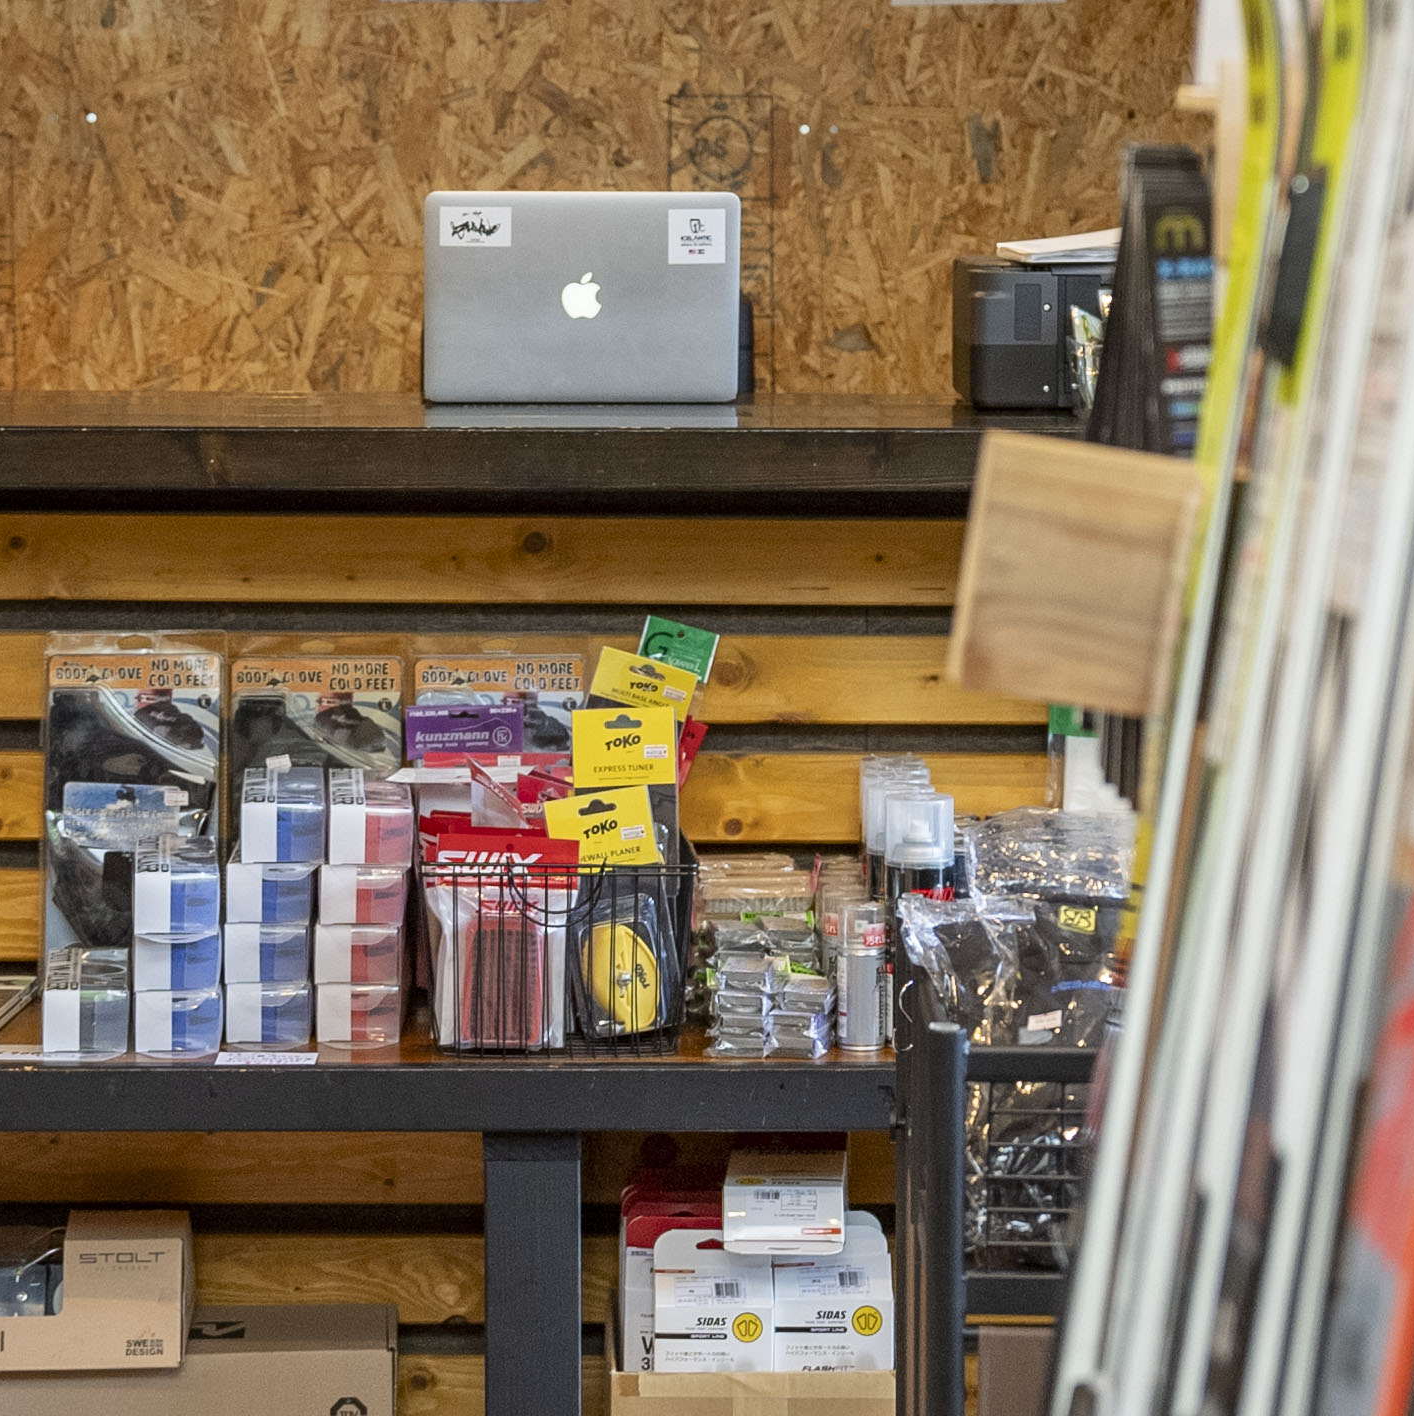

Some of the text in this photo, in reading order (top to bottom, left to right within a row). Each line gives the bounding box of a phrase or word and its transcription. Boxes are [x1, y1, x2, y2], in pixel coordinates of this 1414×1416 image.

[151, 658, 209, 671] NO MORE
[331, 663, 389, 675] NO MORE
[516, 663, 573, 675] NO MORE
[55, 666, 87, 680] BOOT
[237, 670, 269, 683] BOOT
[421, 670, 454, 683] BOOT
[149, 673, 214, 687] COLD FEET
[329, 677, 395, 690] COLD FEET
[514, 677, 581, 690] COLD FEET
[629, 680, 658, 693] TOKO
[414, 730, 490, 744] kunzmann
[604, 733, 642, 752] TOKO
[582, 819, 619, 840] TOKO
[609, 845, 642, 859] PLANER
[78, 1250, 166, 1265] STOLT
